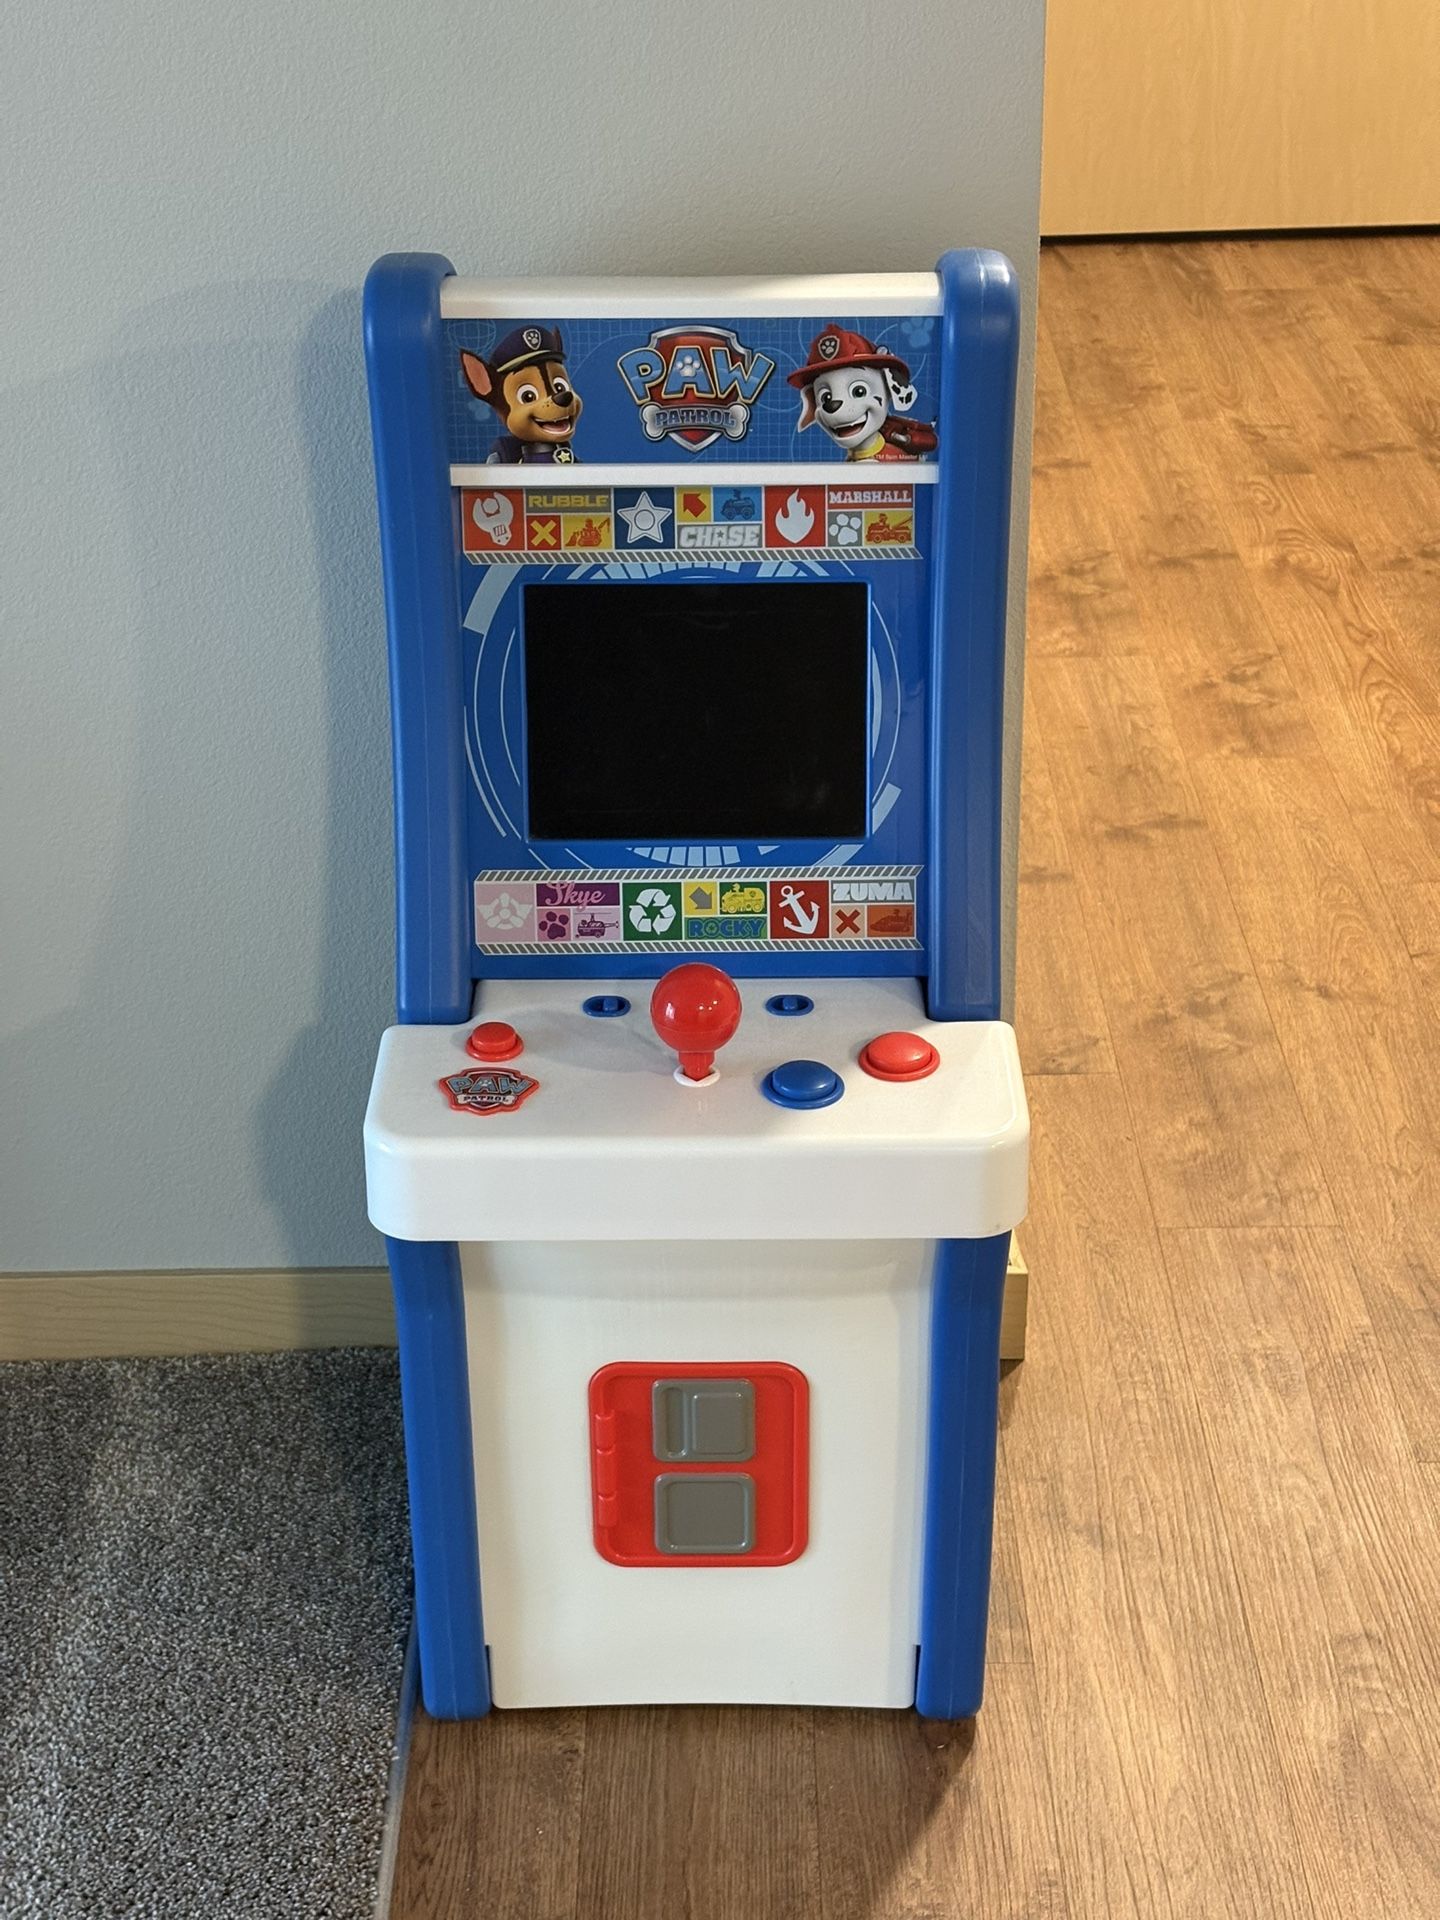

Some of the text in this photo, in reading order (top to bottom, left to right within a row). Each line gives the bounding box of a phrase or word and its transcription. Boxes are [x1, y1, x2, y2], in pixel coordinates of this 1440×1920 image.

[617, 345, 775, 405] PAW
[655, 409, 735, 427] PATROL
[528, 495, 609, 508] RUBBLE
[829, 490, 912, 503] MARSHALL
[680, 525, 761, 548] CHASE
[545, 881, 606, 912] Skye
[833, 882, 913, 901] ZUMA
[688, 919, 764, 938] ROCKY
[446, 1076, 534, 1096] PAW
[463, 1095, 509, 1103] PATROL
